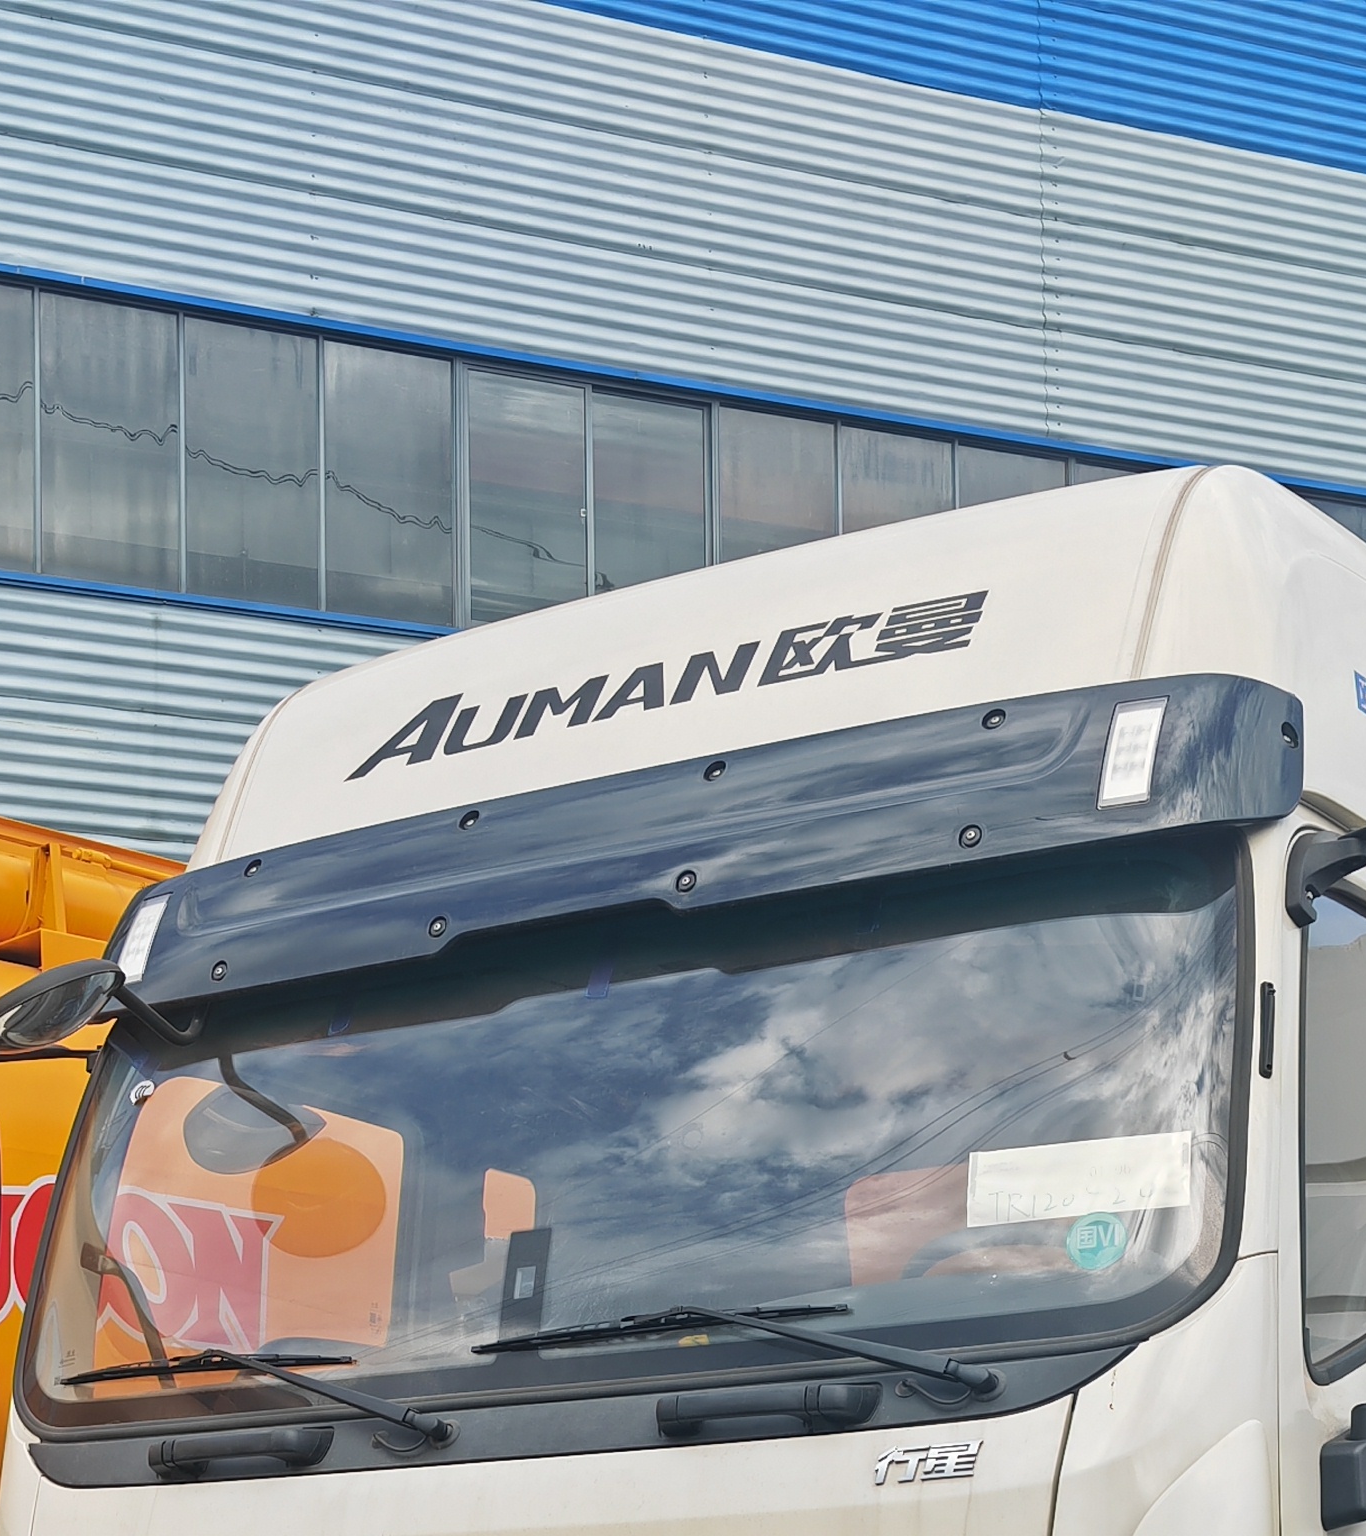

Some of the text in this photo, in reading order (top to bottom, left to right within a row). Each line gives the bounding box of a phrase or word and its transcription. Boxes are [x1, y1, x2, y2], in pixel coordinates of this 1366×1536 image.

[344, 590, 989, 782] AUMAN 欧曼
[874, 1439, 984, 1485] 行星
